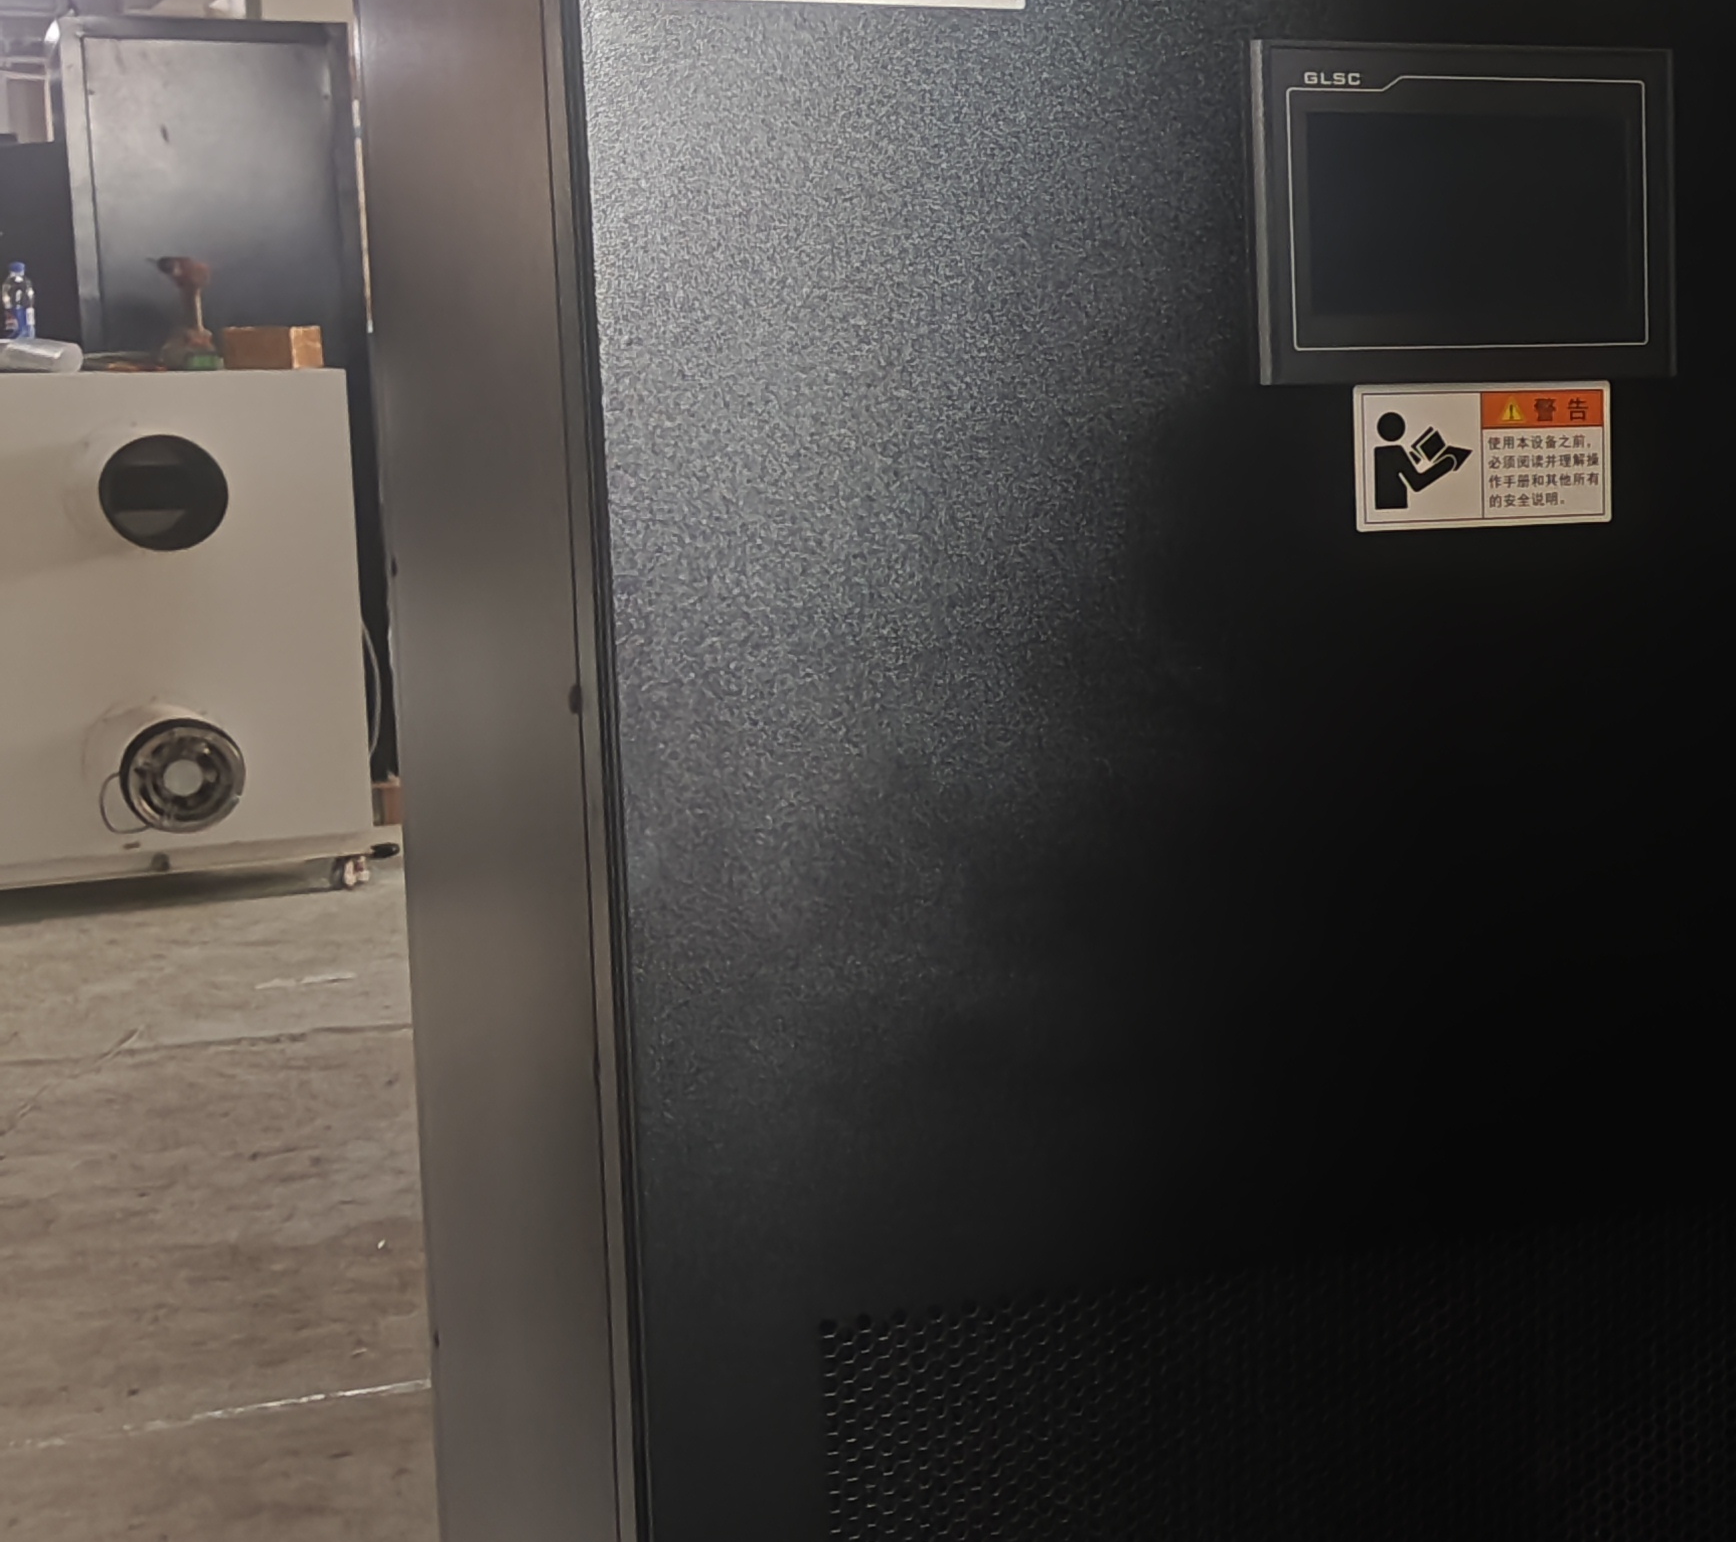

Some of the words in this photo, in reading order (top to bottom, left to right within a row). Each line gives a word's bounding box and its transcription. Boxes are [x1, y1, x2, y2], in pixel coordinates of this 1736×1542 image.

[1303, 71, 1361, 86] GLSC
[1534, 397, 1589, 422] 警告
[1487, 452, 1600, 470] 必须阅读并理解操
[1488, 471, 1600, 489] 作手册和其他所有
[1488, 491, 1566, 509] 的安全说明。
